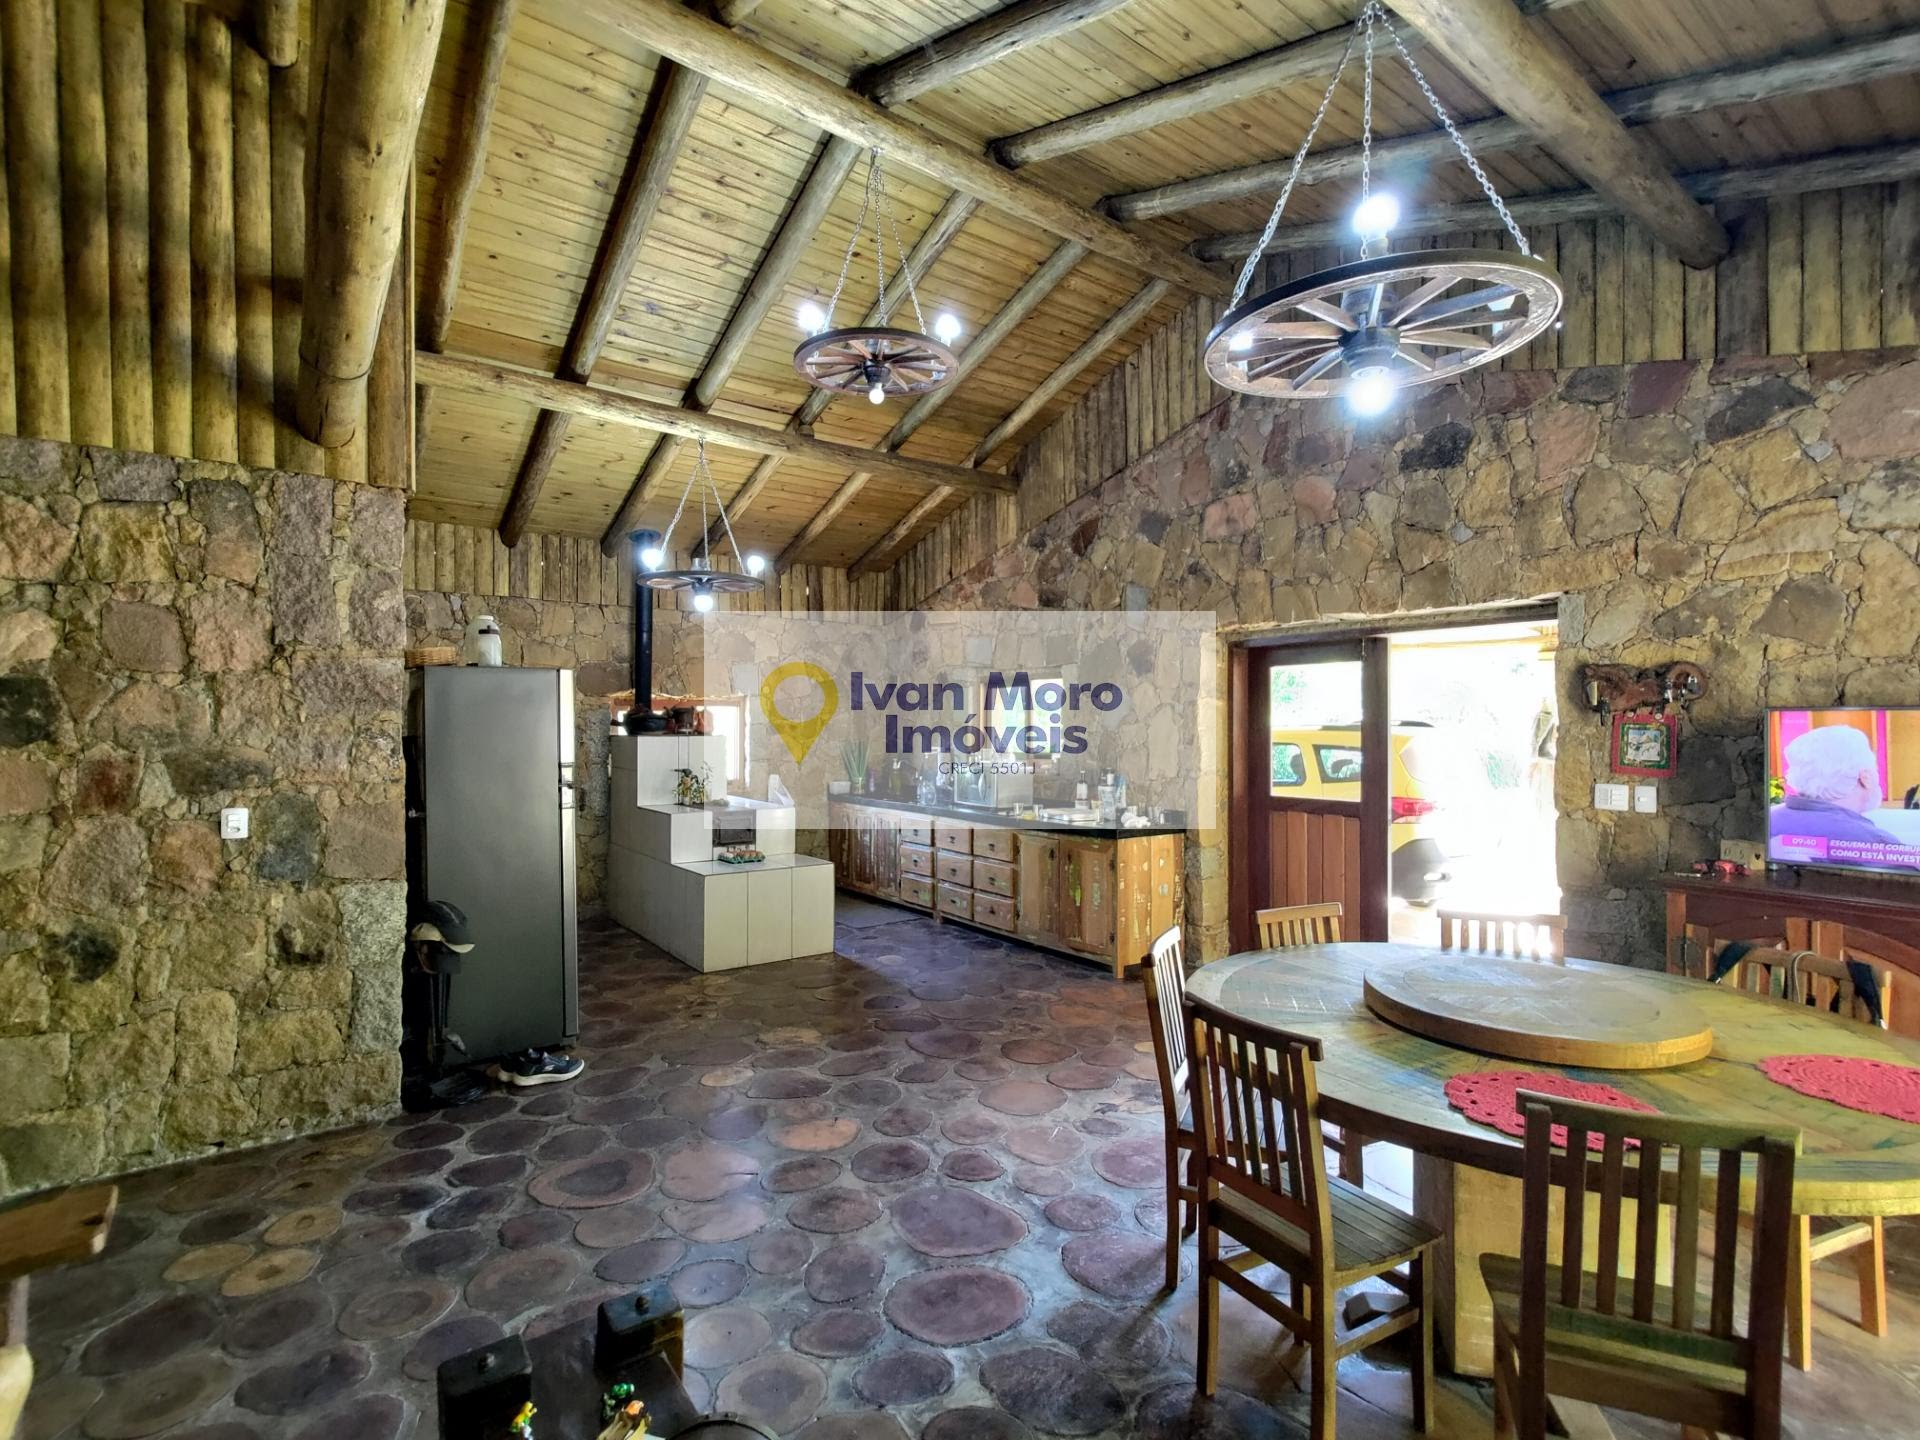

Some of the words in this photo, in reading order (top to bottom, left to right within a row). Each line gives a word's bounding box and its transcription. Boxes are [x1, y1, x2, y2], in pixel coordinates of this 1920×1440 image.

[1792, 838, 1817, 846] 09:40
[1830, 839, 1871, 850] ESQUEMA
[1872, 842, 1885, 850] DE
[1830, 848, 1860, 858] COMO
[1861, 850, 1885, 861] ESTÁ
